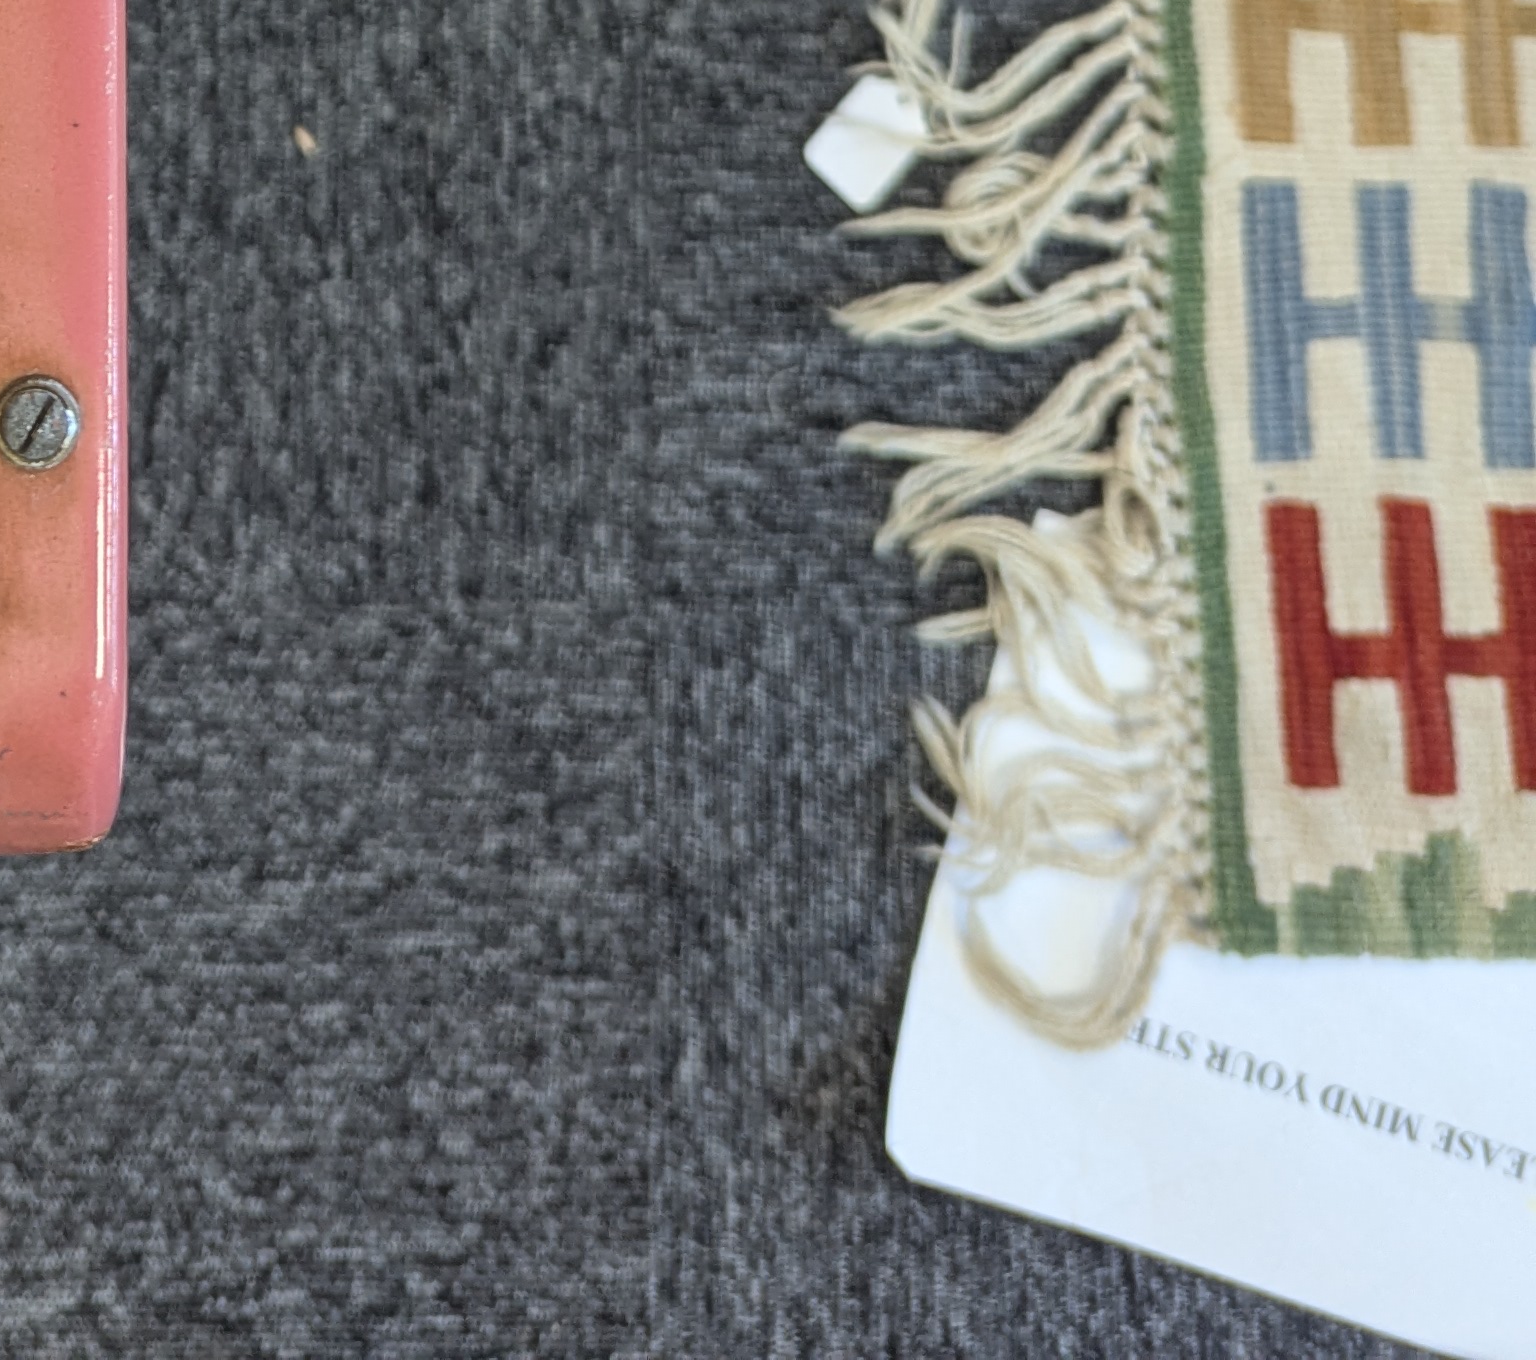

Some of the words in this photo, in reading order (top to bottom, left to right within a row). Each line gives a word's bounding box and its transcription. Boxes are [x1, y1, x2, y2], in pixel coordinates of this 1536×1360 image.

[1124, 1016, 1197, 1062] STE
[1205, 1037, 1310, 1105] YOUR
[1319, 1083, 1426, 1144] MIND
[1433, 1119, 1536, 1181] EASE
